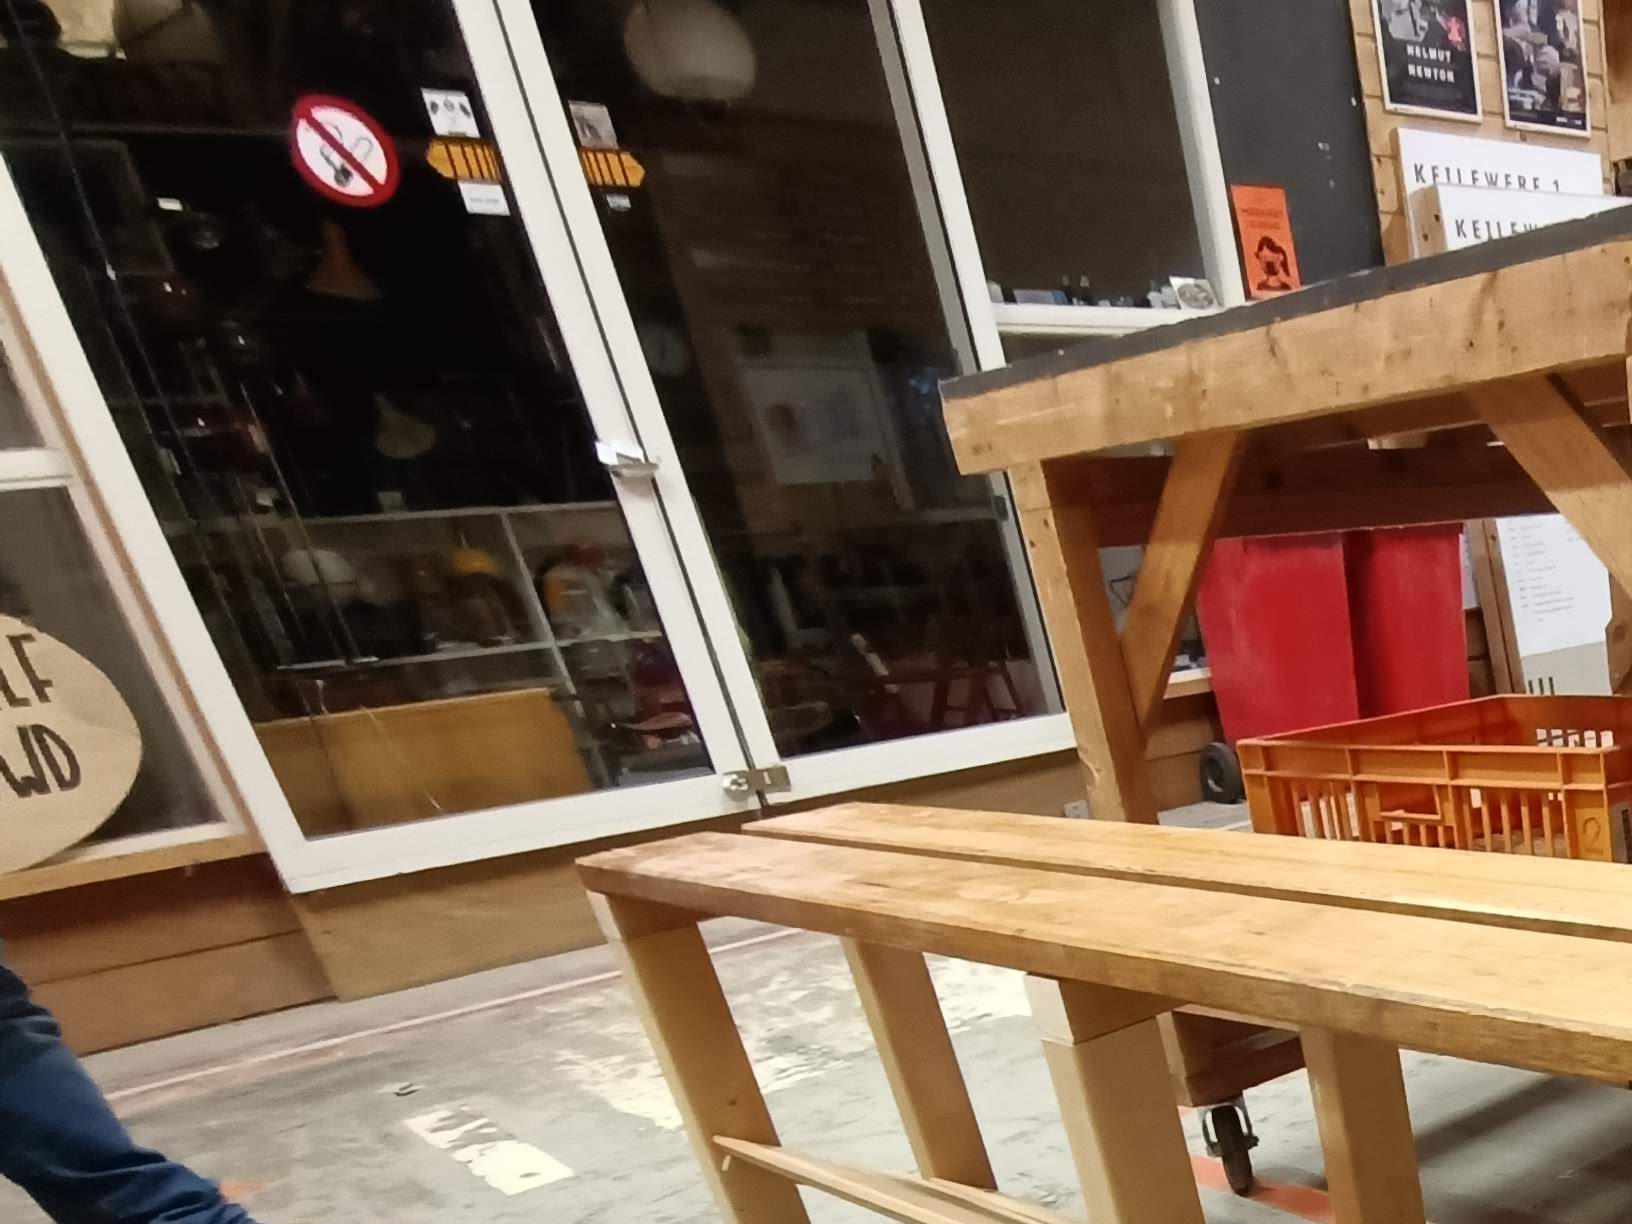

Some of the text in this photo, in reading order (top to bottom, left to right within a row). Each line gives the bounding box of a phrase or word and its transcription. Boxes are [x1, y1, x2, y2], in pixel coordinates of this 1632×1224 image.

[1406, 44, 1451, 63] HELMUT
[1407, 64, 1455, 83] NEWTON
[0, 633, 53, 709] LF
[1582, 816, 1604, 856] 2
